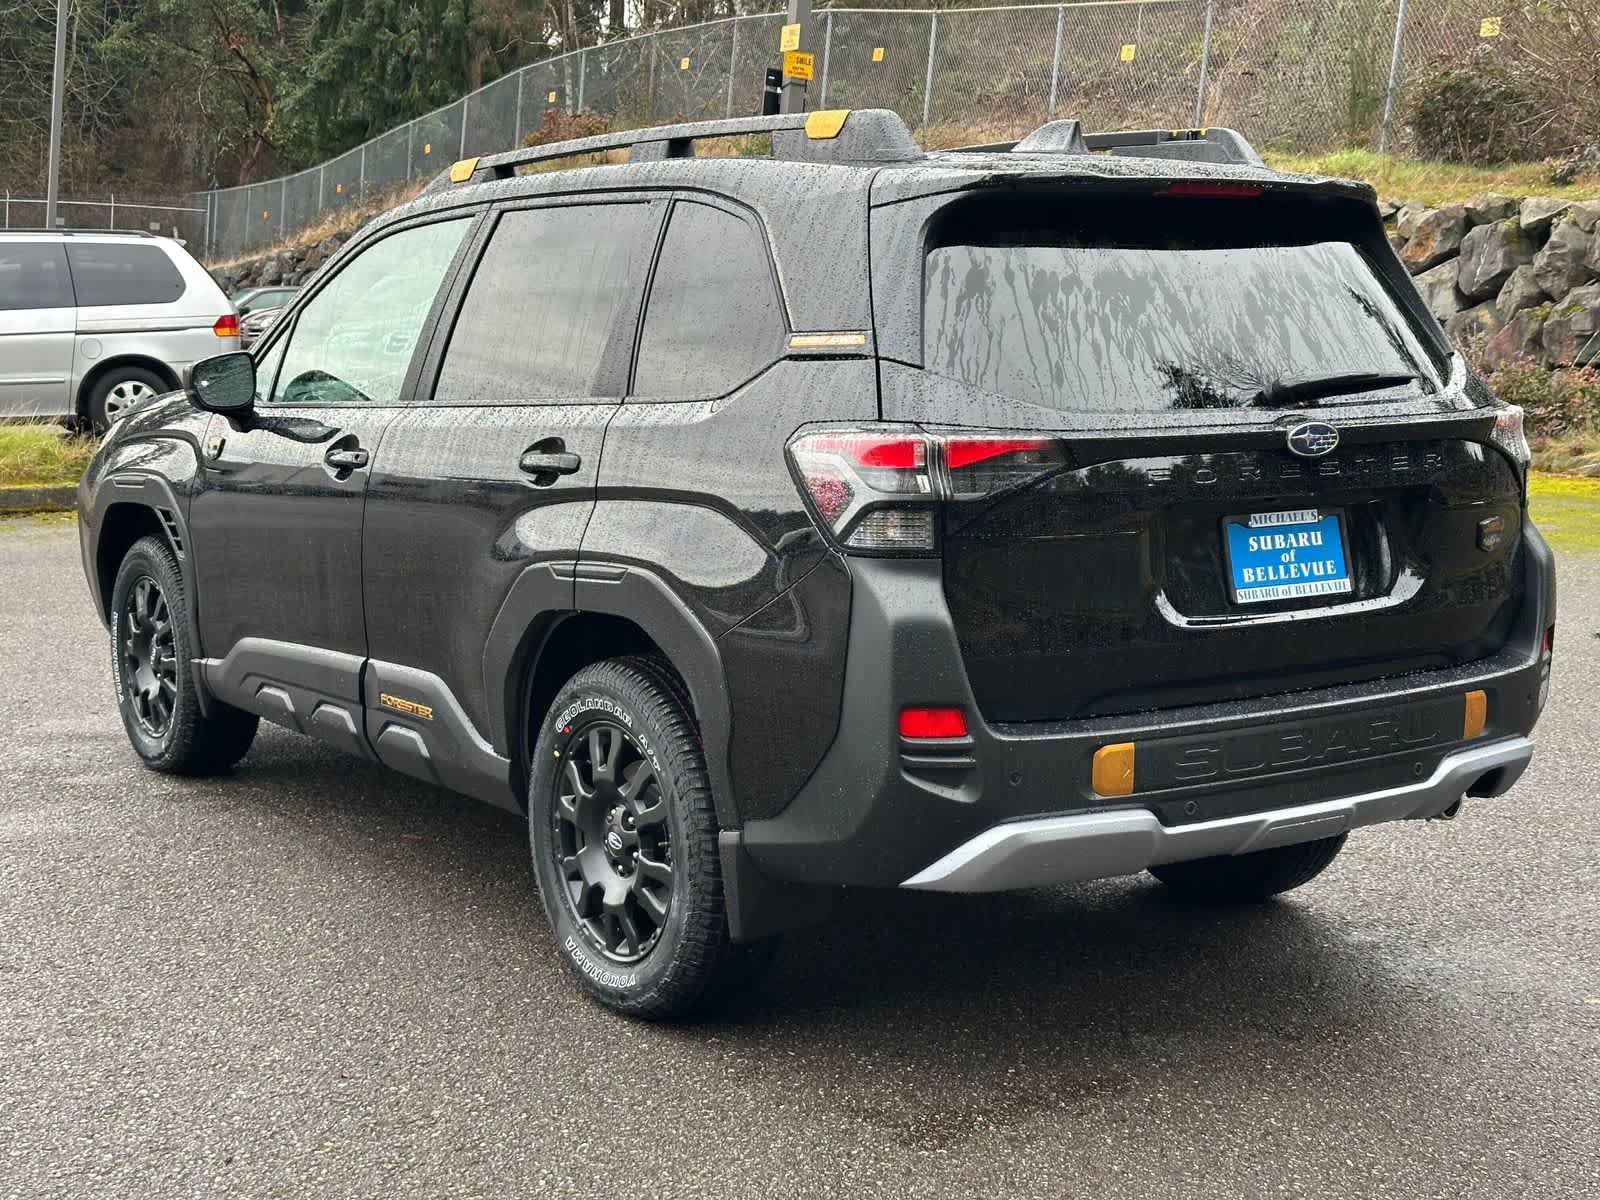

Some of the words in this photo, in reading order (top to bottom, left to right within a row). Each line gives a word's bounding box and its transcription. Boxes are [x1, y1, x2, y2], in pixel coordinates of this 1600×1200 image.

[1146, 453, 1444, 487] FORESTER
[1252, 510, 1318, 526] MICHAEL'S
[1248, 531, 1323, 552] SUBARU
[1281, 549, 1296, 563] of
[1242, 559, 1337, 584] BELLEVUE
[1238, 588, 1279, 601] SUBARU
[1281, 587, 1292, 598] of
[1295, 581, 1348, 596] BELLEVUE
[380, 693, 433, 720] FORESTER
[555, 698, 633, 732] GEOLANDAR
[1175, 715, 1441, 780] SUBARU
[565, 936, 636, 989] YOKOHAMA
